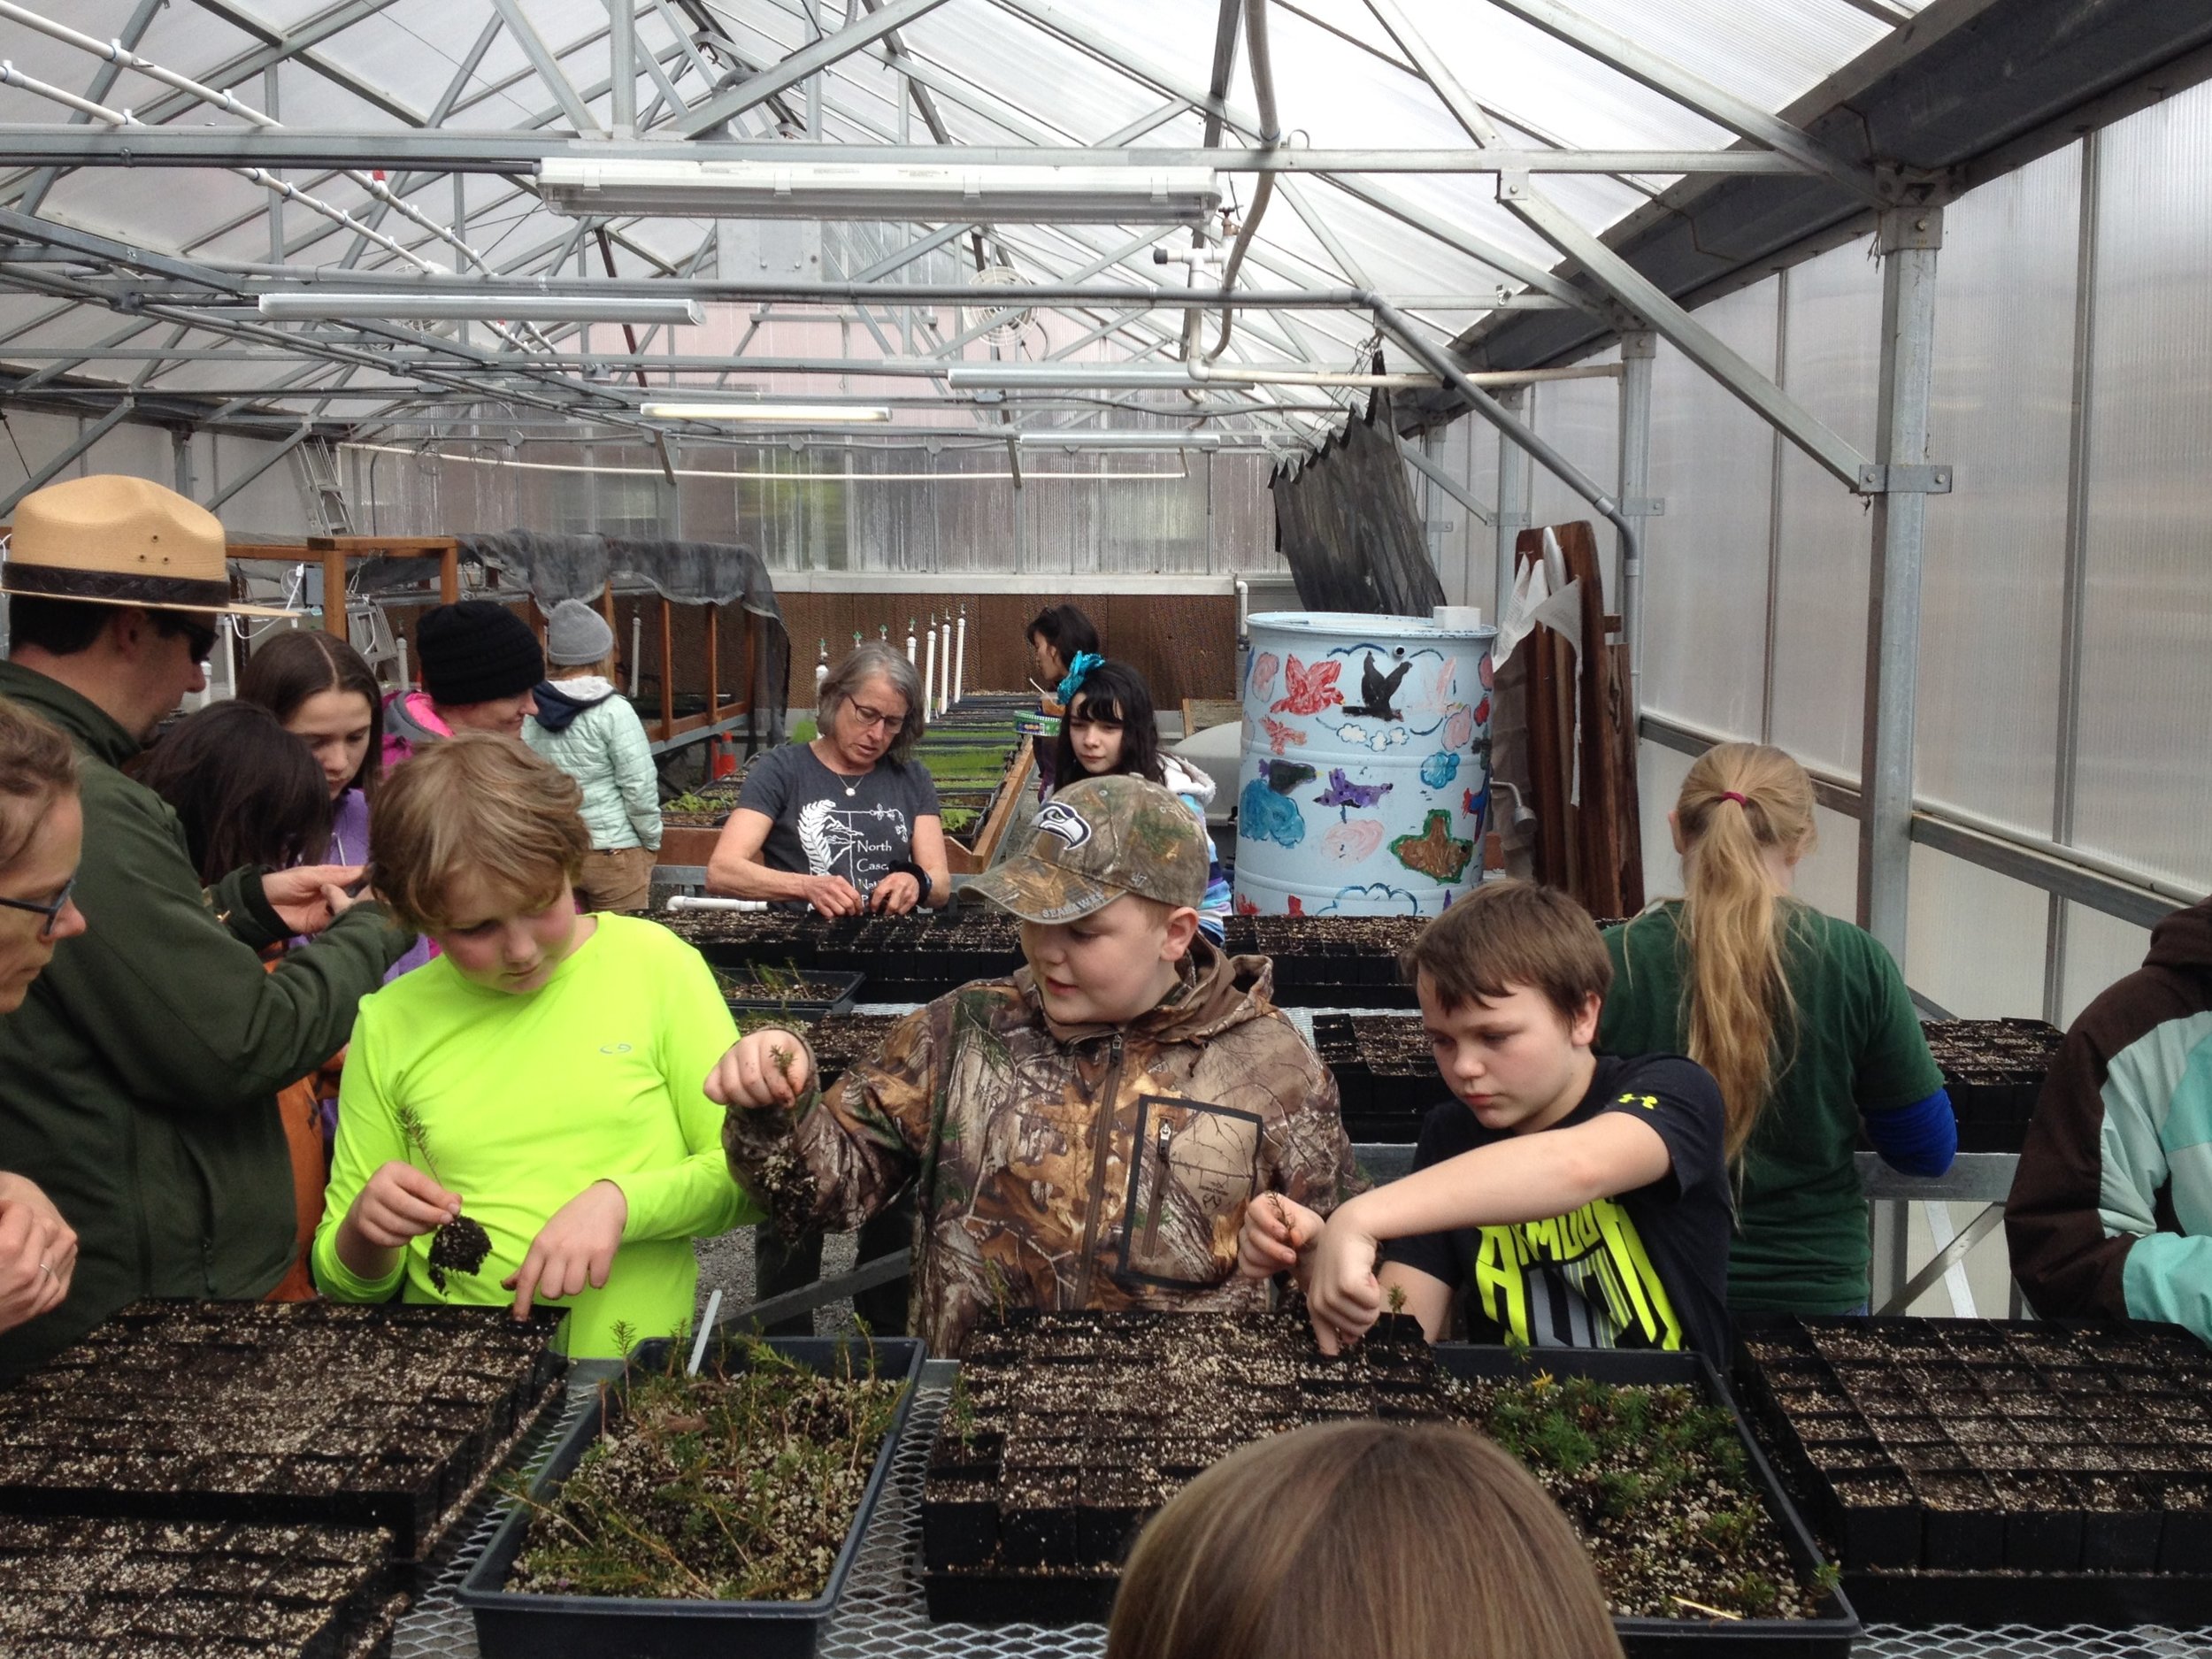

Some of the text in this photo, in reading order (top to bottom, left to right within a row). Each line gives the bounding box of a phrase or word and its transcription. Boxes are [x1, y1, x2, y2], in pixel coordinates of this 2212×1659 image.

[857, 840, 893, 853] North
[856, 858, 889, 872] Casc
[858, 879, 879, 890] Nat
[1041, 891, 1105, 918] SEAHAWKS
